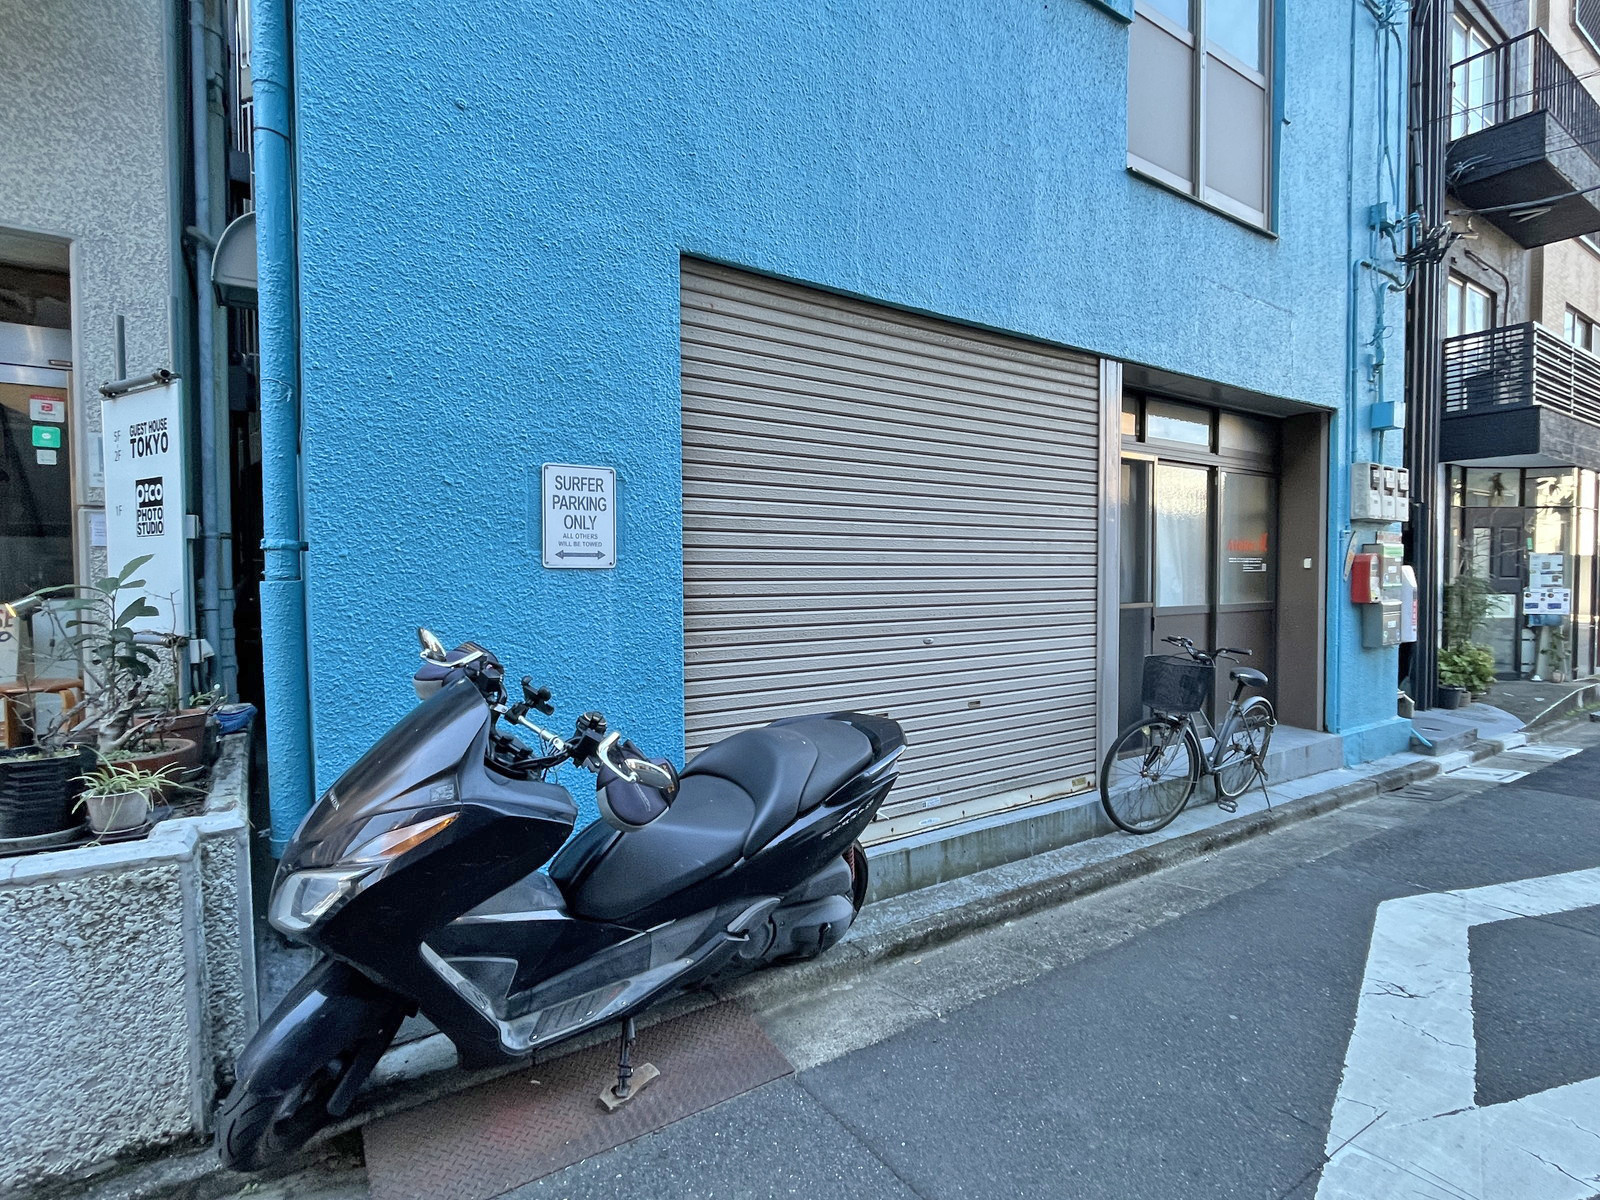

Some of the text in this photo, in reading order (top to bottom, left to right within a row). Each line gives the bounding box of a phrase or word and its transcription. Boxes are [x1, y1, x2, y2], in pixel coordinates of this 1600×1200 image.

[129, 418, 168, 437] GUEST HOUSE
[129, 431, 169, 458] TOKYO
[554, 475, 604, 492] SURFER
[552, 494, 607, 512] PARKING
[136, 507, 163, 521] PHOTO
[563, 514, 597, 530] ONLY
[136, 521, 164, 535] STUDIO
